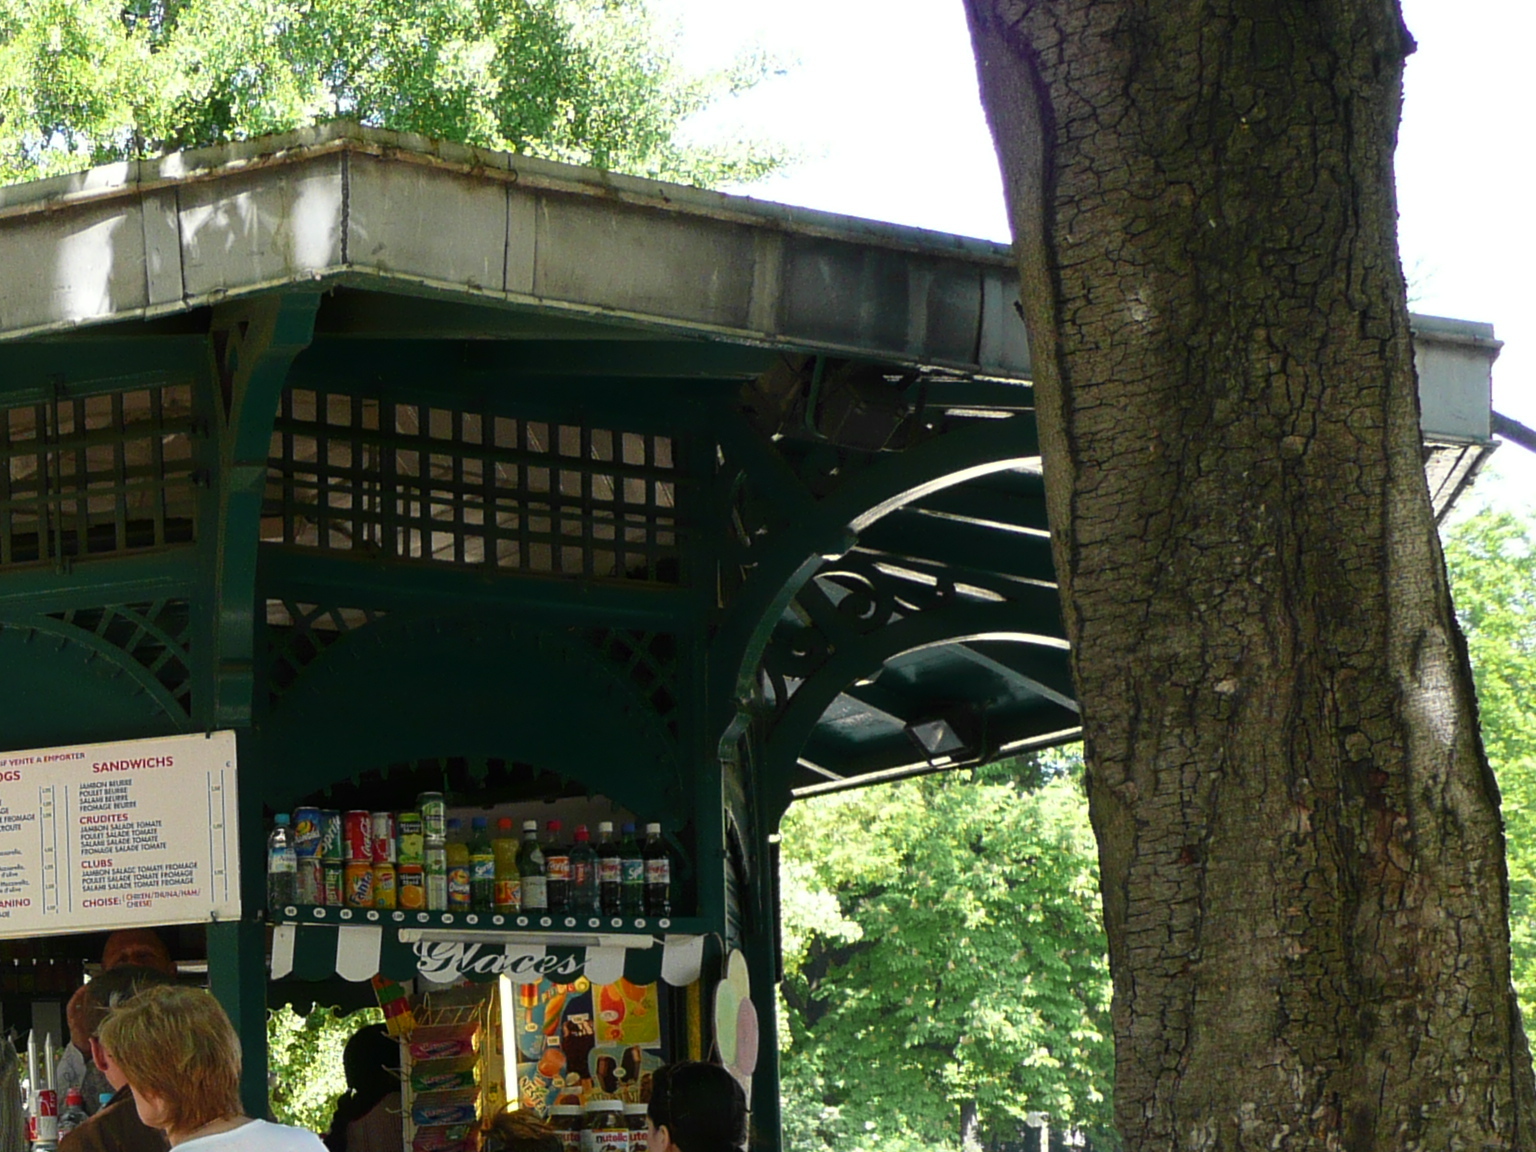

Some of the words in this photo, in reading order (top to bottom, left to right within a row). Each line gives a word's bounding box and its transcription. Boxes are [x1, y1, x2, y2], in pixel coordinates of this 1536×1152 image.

[10, 757, 34, 767] VENTE
[44, 753, 85, 762] EMPORTER
[93, 756, 173, 773] SANDWICHS
[80, 780, 107, 789] JAMBON
[79, 789, 102, 797] POULET
[80, 803, 111, 812] FROMAGE
[4, 814, 35, 823] FROMAGE
[80, 813, 128, 824] CRUDITES
[81, 825, 108, 833] JAMBON
[111, 822, 134, 830] SALADE
[137, 820, 162, 828] TOMATE
[106, 830, 130, 838] SALADE
[132, 828, 157, 836] TOMATE
[107, 838, 131, 846] SALADE
[81, 847, 113, 855] FROMAGE
[141, 842, 166, 850] TOMATE
[81, 859, 112, 869] CLUBS
[138, 864, 163, 872] TOMATE
[165, 862, 198, 870] FROMAGE
[161, 870, 193, 878] FROMAGE
[134, 880, 159, 888] TOMATE
[161, 878, 193, 886] FROMAGE
[349, 870, 373, 905] Fanta
[83, 897, 122, 908] CHOISE:
[413, 940, 592, 975] Glaces
